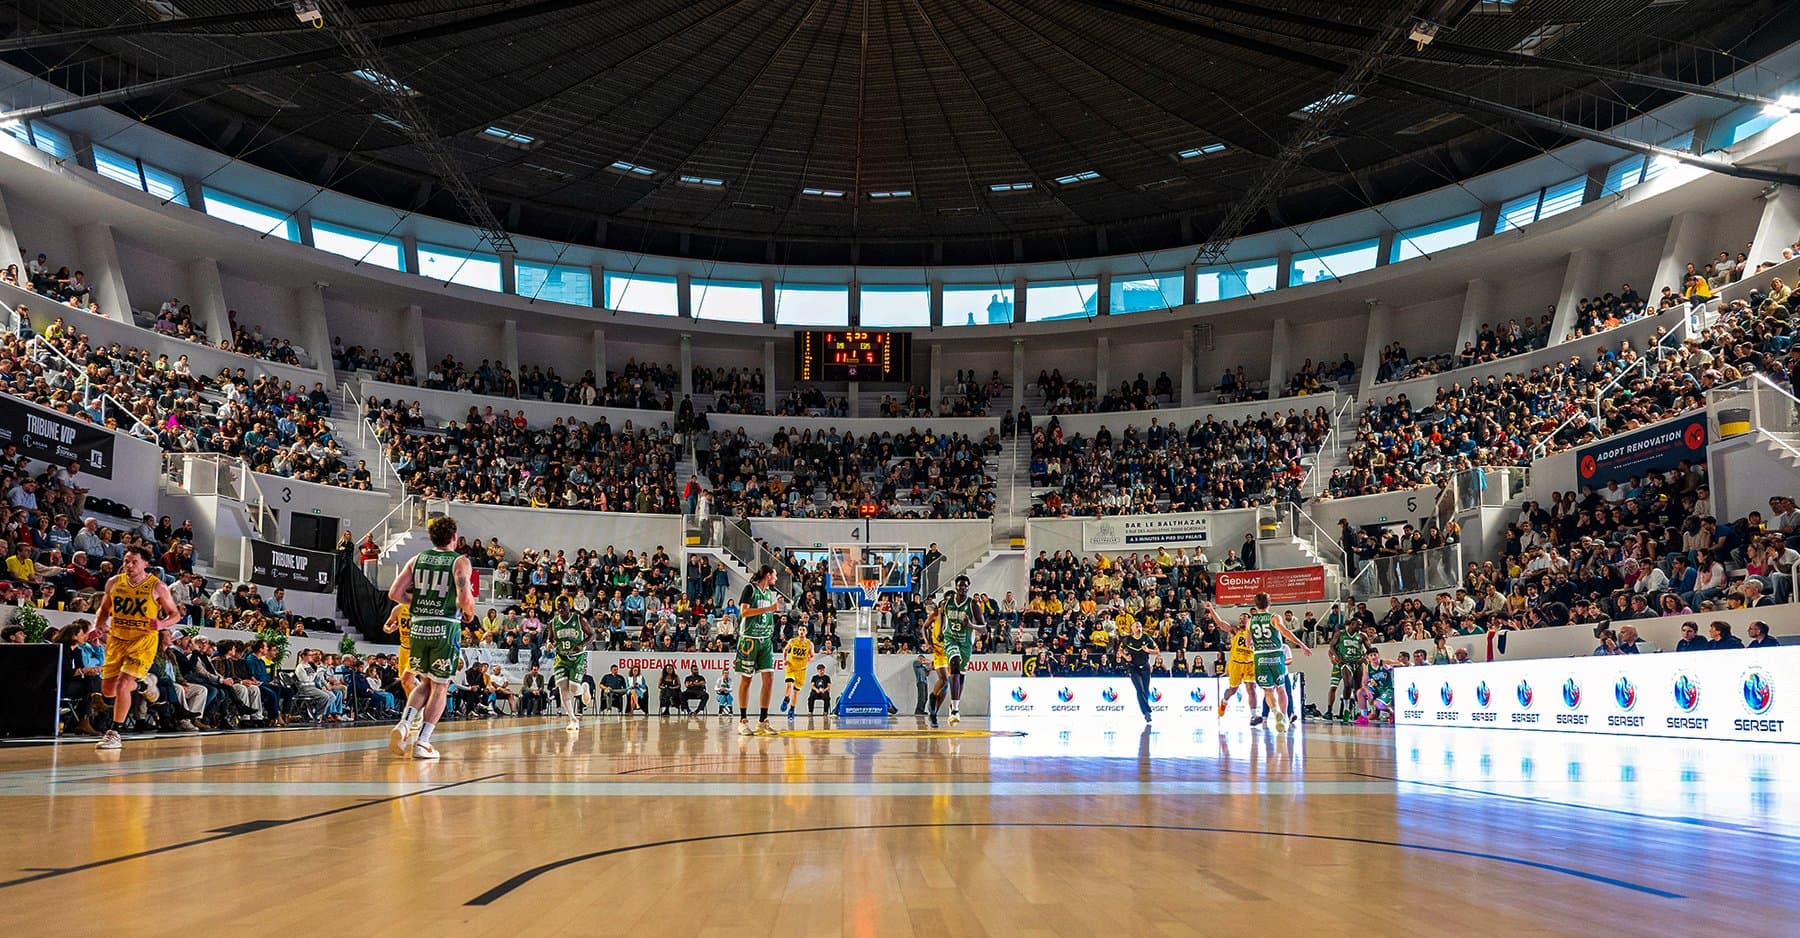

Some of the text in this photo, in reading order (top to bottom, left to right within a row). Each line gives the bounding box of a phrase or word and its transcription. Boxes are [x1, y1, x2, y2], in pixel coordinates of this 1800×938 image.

[26, 413, 60, 442] TRIBUNE
[60, 424, 76, 444] VIP
[1596, 431, 1682, 462] ADOPT RENOVATION
[282, 486, 292, 503] 3
[1408, 496, 1416, 512] 5
[1158, 518, 1206, 527] BALTHAZAR
[851, 528, 860, 540] 4
[272, 550, 308, 570] TRIBUNE VIP
[414, 568, 449, 598] 44
[762, 614, 766, 622] 3
[951, 622, 961, 632] 23
[1252, 624, 1272, 638] 35
[562, 640, 571, 649] 19
[618, 658, 677, 670] BORDEAUX
[680, 658, 697, 670] MA
[700, 658, 730, 670] VILLE
[992, 661, 1008, 672] MA
[1472, 712, 1498, 722] SERSET
[1511, 713, 1540, 723] SERSET
[1556, 714, 1589, 725] SERSET
[1608, 716, 1645, 727] SERSET
[1666, 717, 1709, 730] SERSET
[1734, 719, 1784, 732] SERSET
